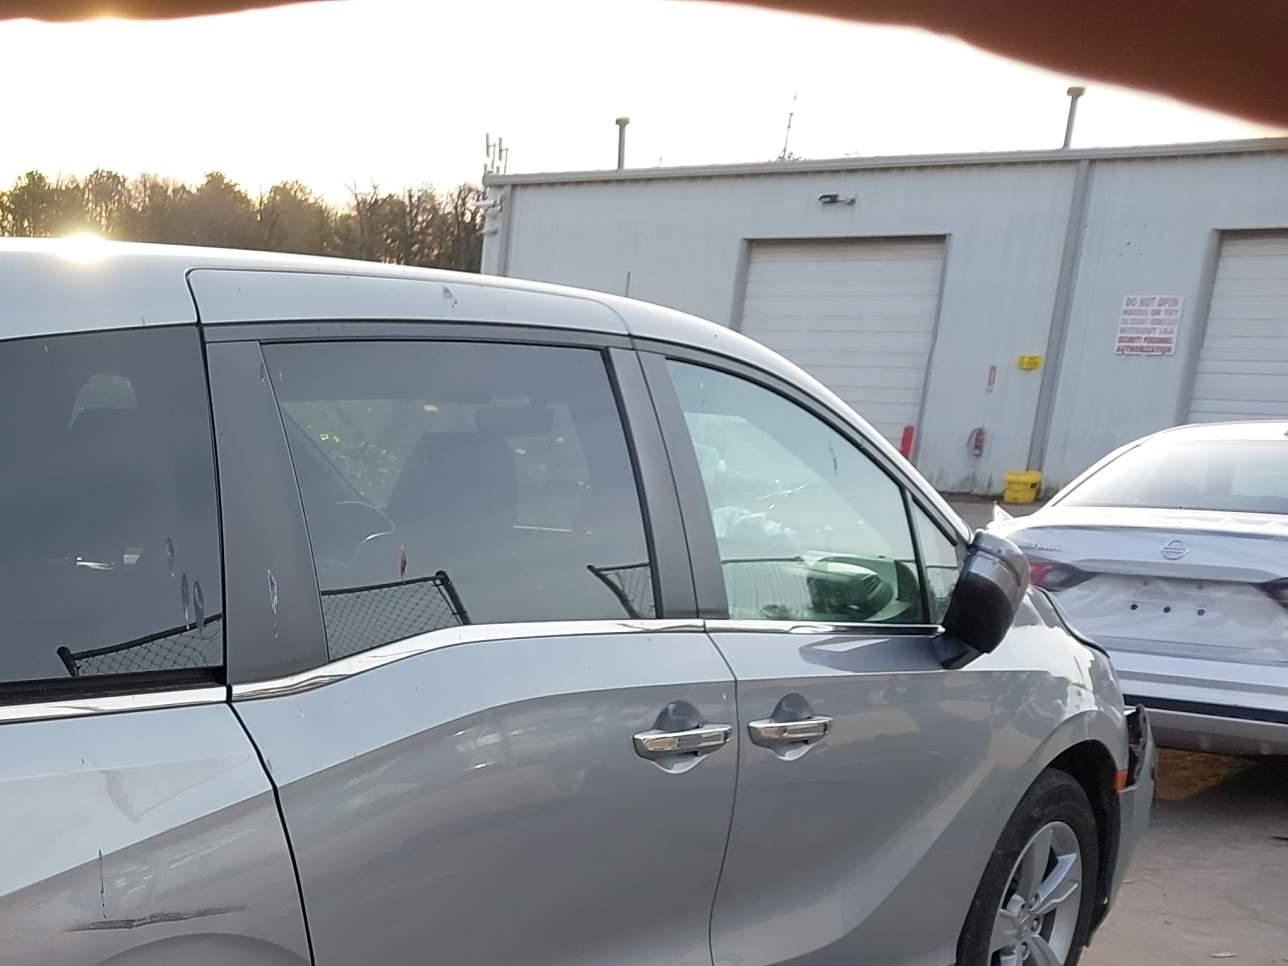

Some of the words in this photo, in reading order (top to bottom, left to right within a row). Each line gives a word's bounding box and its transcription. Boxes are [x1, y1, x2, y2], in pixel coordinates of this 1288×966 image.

[1125, 297, 1138, 307] DO
[1139, 297, 1156, 307] NOT
[1158, 297, 1179, 307] OPEN
